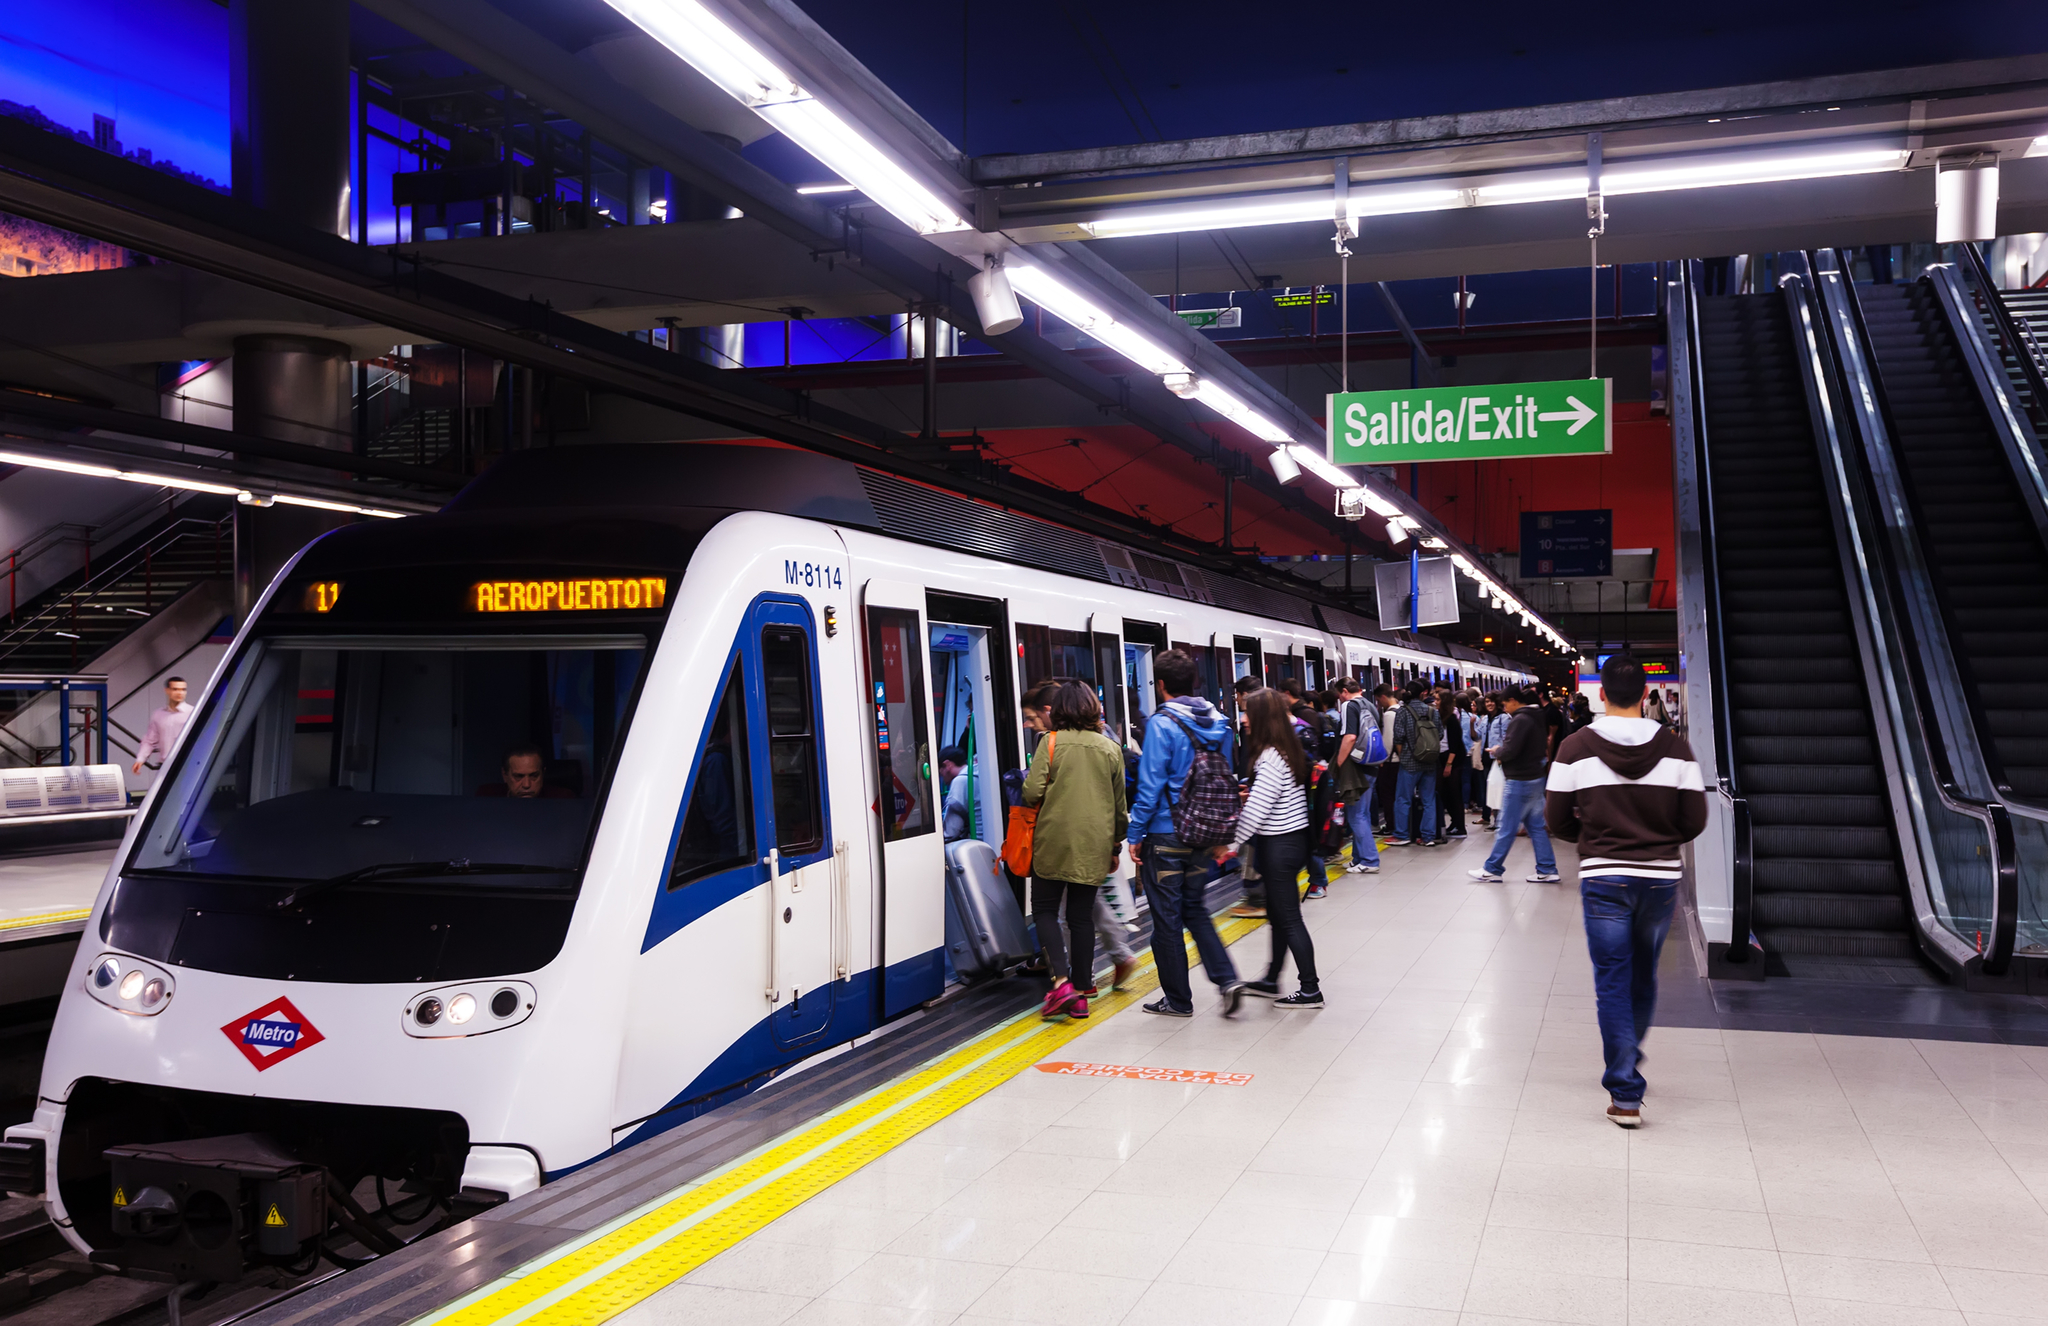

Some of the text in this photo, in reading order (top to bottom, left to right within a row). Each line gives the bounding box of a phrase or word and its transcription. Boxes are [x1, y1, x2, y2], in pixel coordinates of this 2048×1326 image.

[1344, 395, 1538, 447] Salida/Exit
[1541, 516, 1549, 528] 6
[1538, 538, 1552, 550] 10
[1541, 561, 1549, 572] 8
[785, 560, 842, 590] M-8114
[317, 583, 338, 611] 11
[248, 1022, 295, 1043] Metro
[1057, 1067, 1247, 1086] PARADA TREN
[1071, 1063, 1184, 1076] COCHES
[1214, 1072, 1252, 1080] DE
